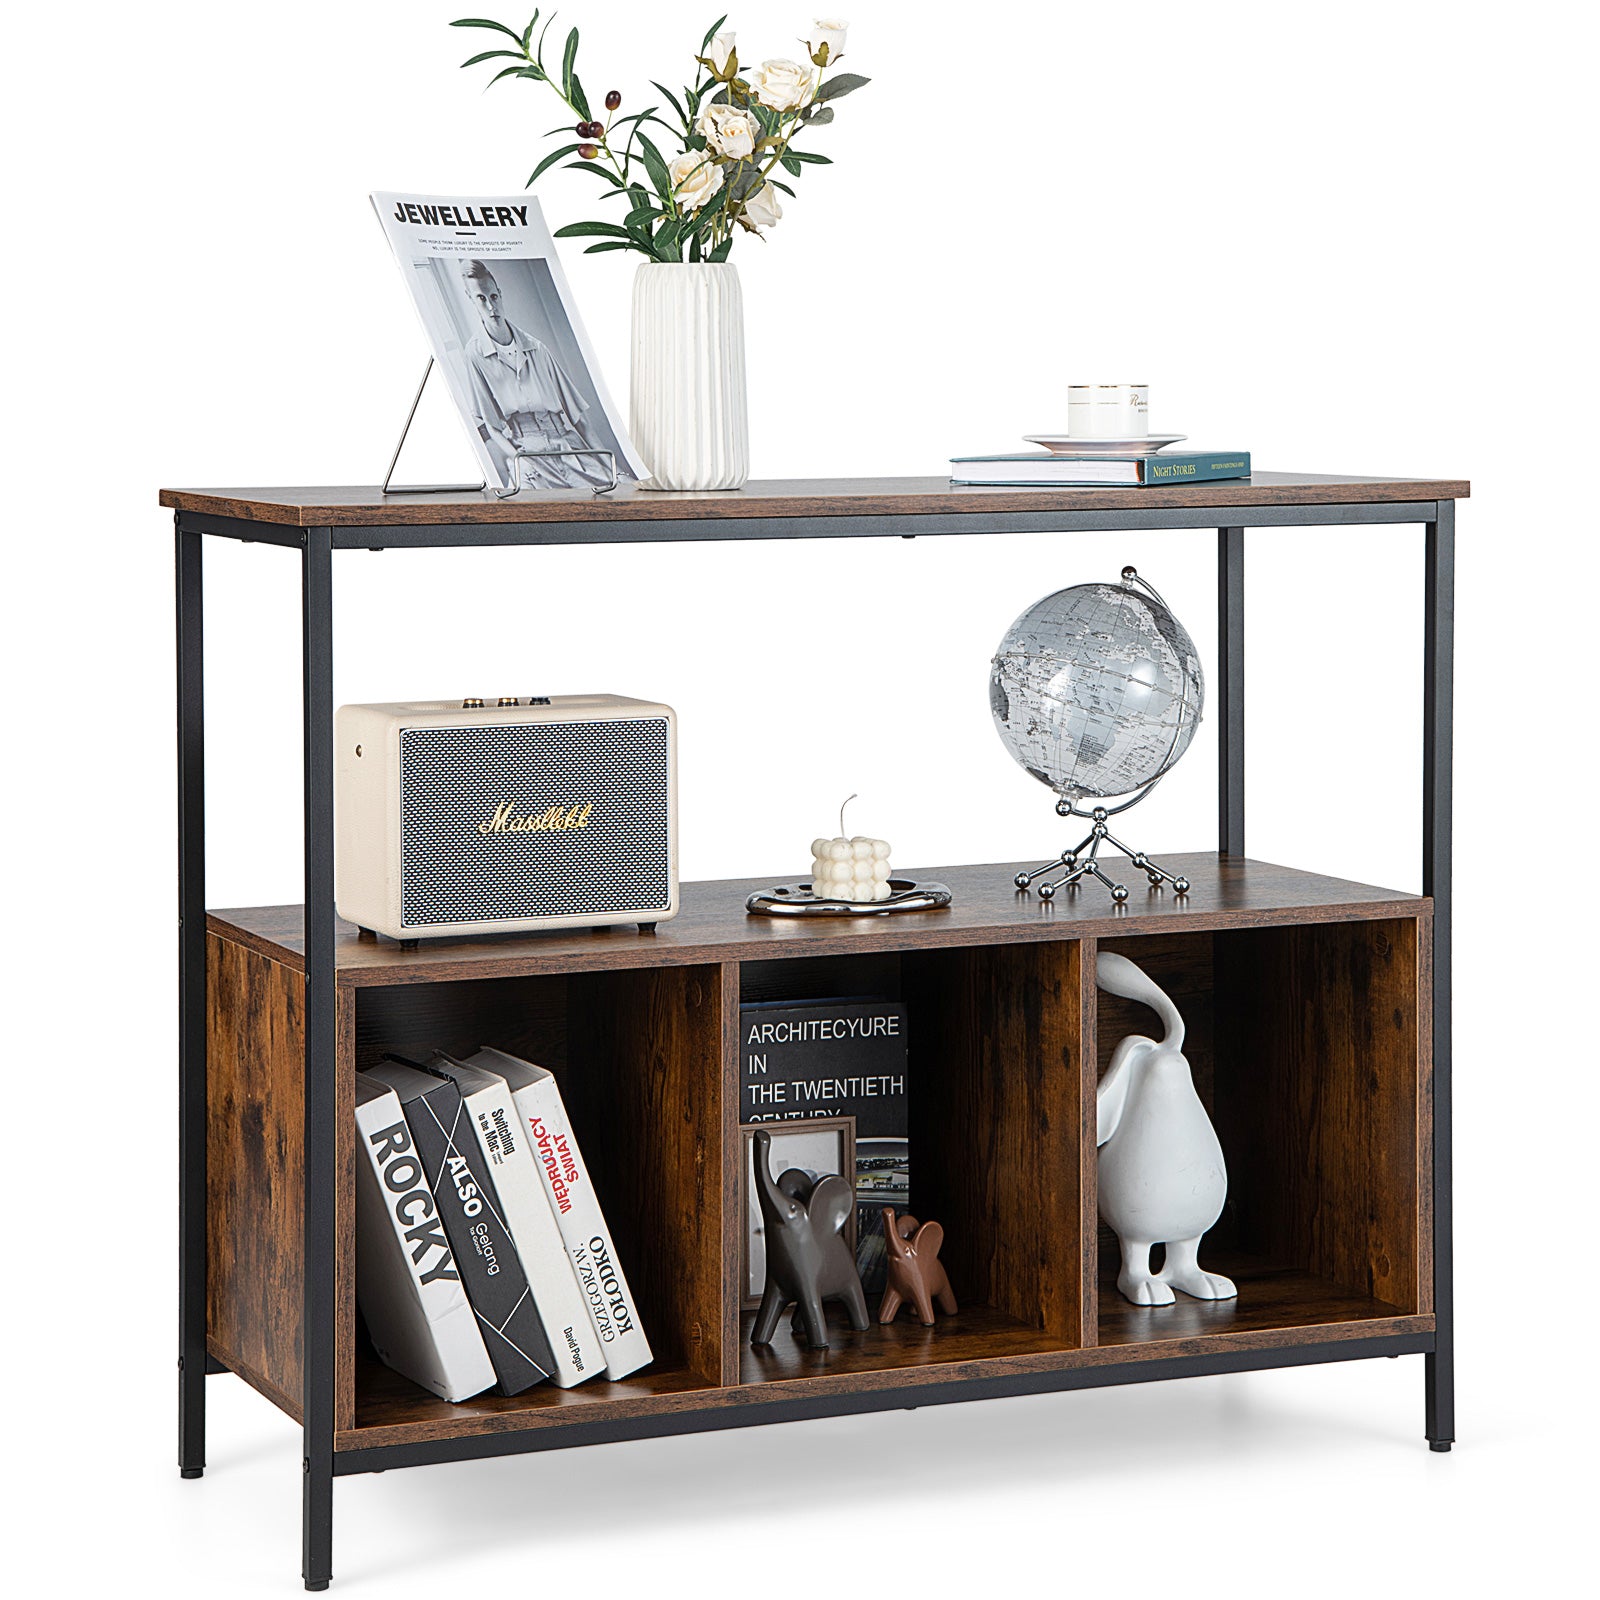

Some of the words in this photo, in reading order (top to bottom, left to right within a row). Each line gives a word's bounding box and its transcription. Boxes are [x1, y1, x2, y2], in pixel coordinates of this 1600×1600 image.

[394, 202, 529, 227] JEWELLERY
[747, 1016, 900, 1045] ARCHITECYURE
[749, 1054, 767, 1075] IN
[748, 1082, 786, 1105] THE
[791, 1075, 904, 1101] TWENTIETH
[484, 1130, 500, 1153] Mac
[491, 1108, 516, 1156] Switching
[529, 1117, 572, 1215] WĘDRUJĄCY
[552, 1133, 579, 1183] ŚWIAT
[369, 1120, 460, 1286] ROCKY
[447, 1156, 483, 1218] ALSO
[475, 1222, 500, 1276] Gelang
[572, 1242, 588, 1264] W.
[579, 1262, 616, 1343] GRZEGORZ
[589, 1235, 634, 1336] KOŁODKO
[563, 1326, 579, 1349] David
[570, 1347, 585, 1372] Pogue
